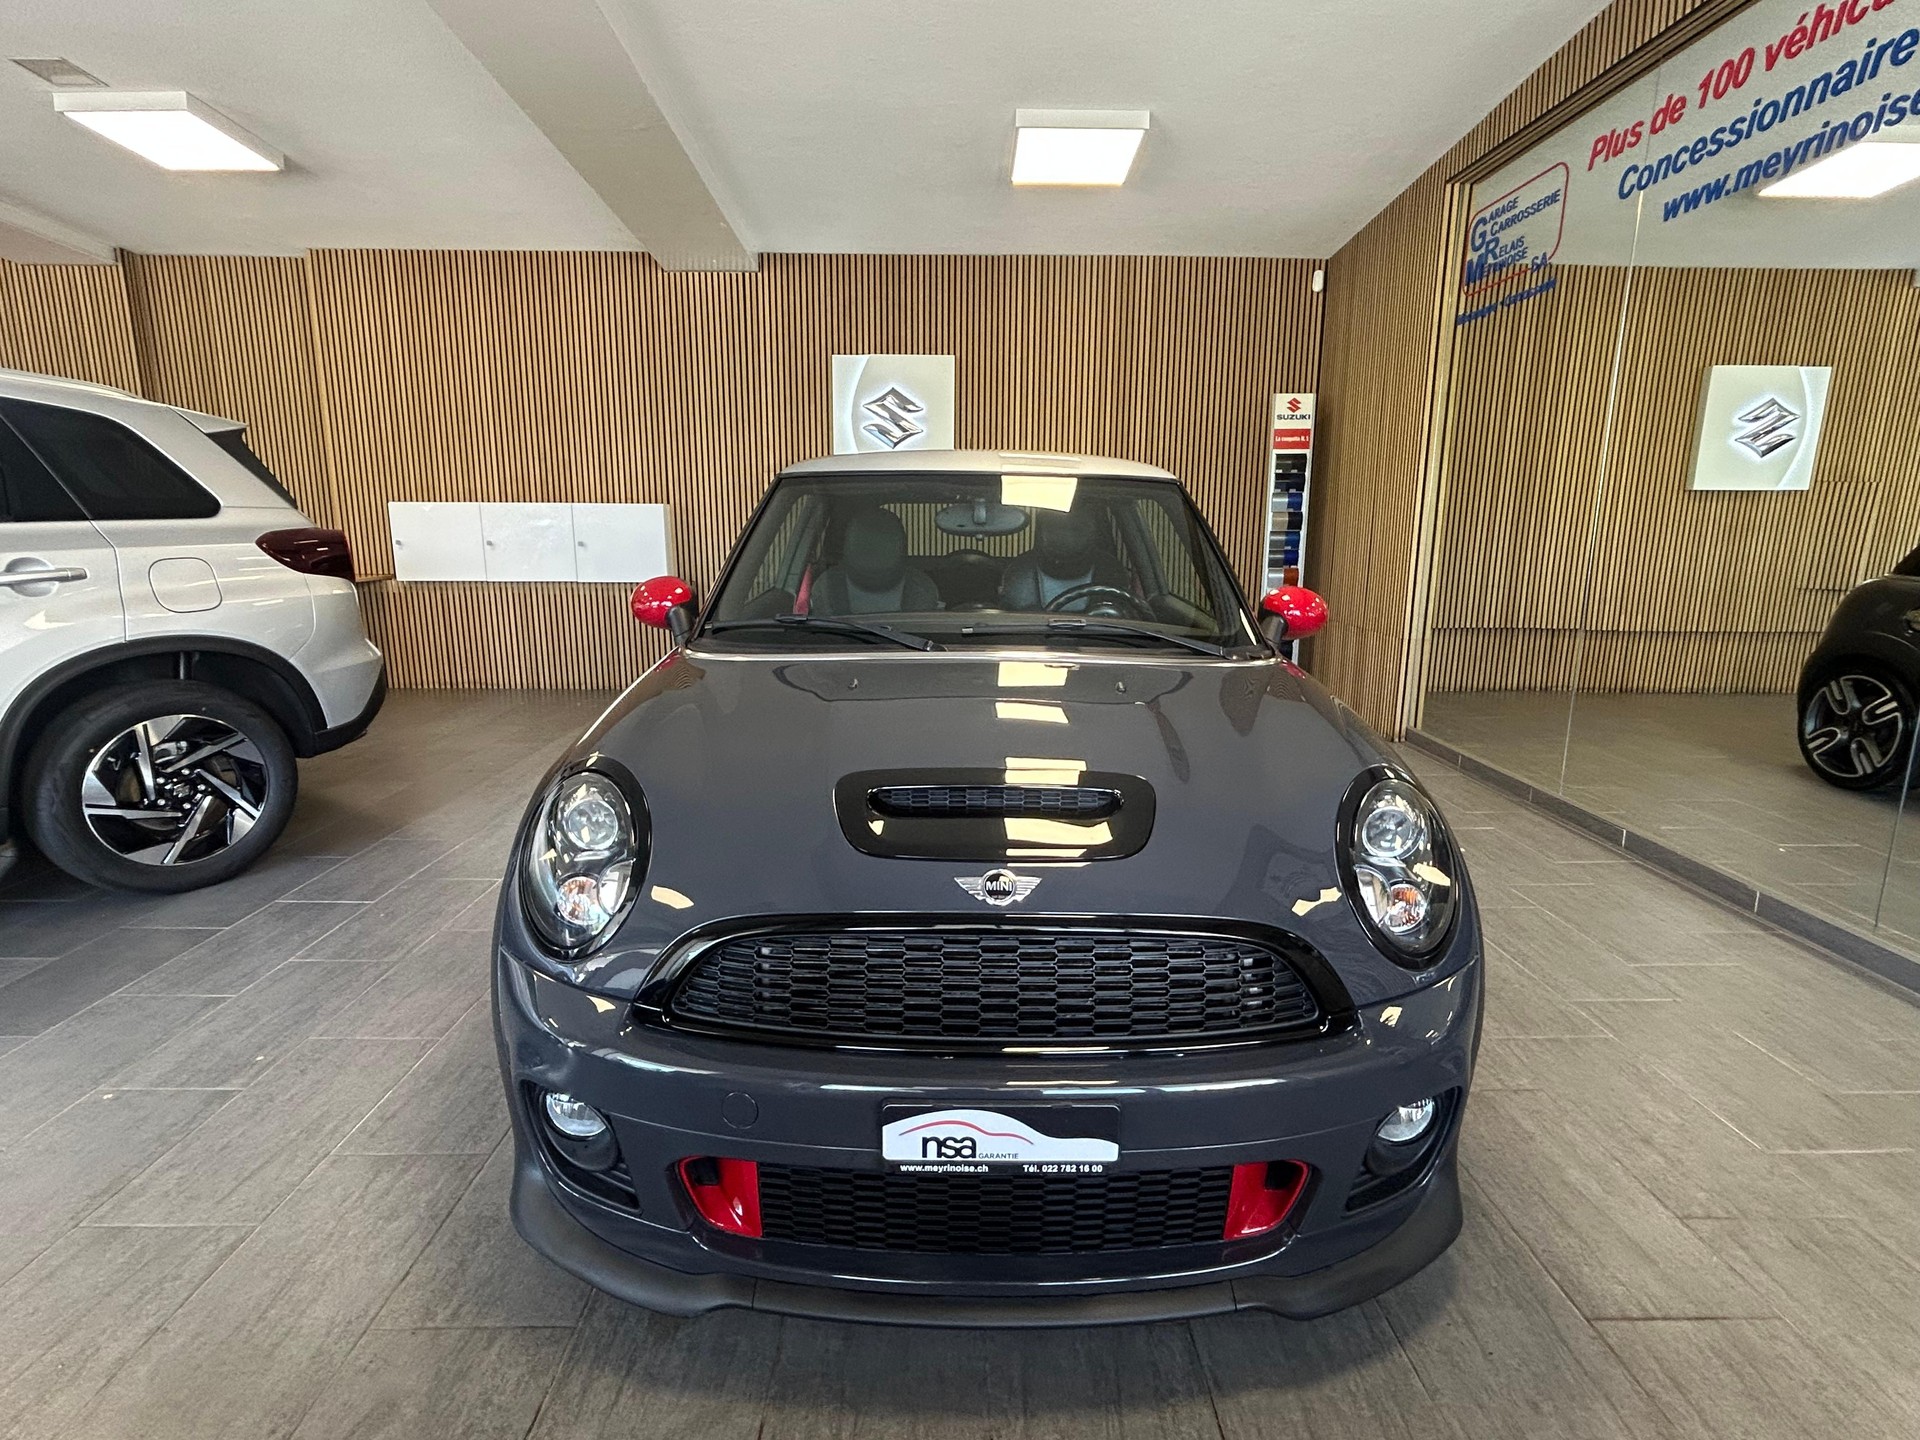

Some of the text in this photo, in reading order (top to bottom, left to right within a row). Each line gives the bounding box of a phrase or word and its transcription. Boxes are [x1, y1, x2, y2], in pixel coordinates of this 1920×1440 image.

[1588, 120, 1644, 171] Plus
[1649, 93, 1687, 135] de
[1698, 47, 1755, 109] 100
[1618, 28, 1919, 200] Concessionnaire
[1471, 196, 1519, 252] GARAGE
[1490, 189, 1561, 236] CARROSSERIE
[1484, 235, 1525, 263] RELAIS
[1531, 252, 1548, 273] SA
[986, 881, 1012, 891] MINI
[922, 1136, 977, 1159] nsa
[900, 1164, 988, 1173] www.meyrinoise.ch
[1023, 1164, 1103, 1173] Tél. 022 782 16 00
